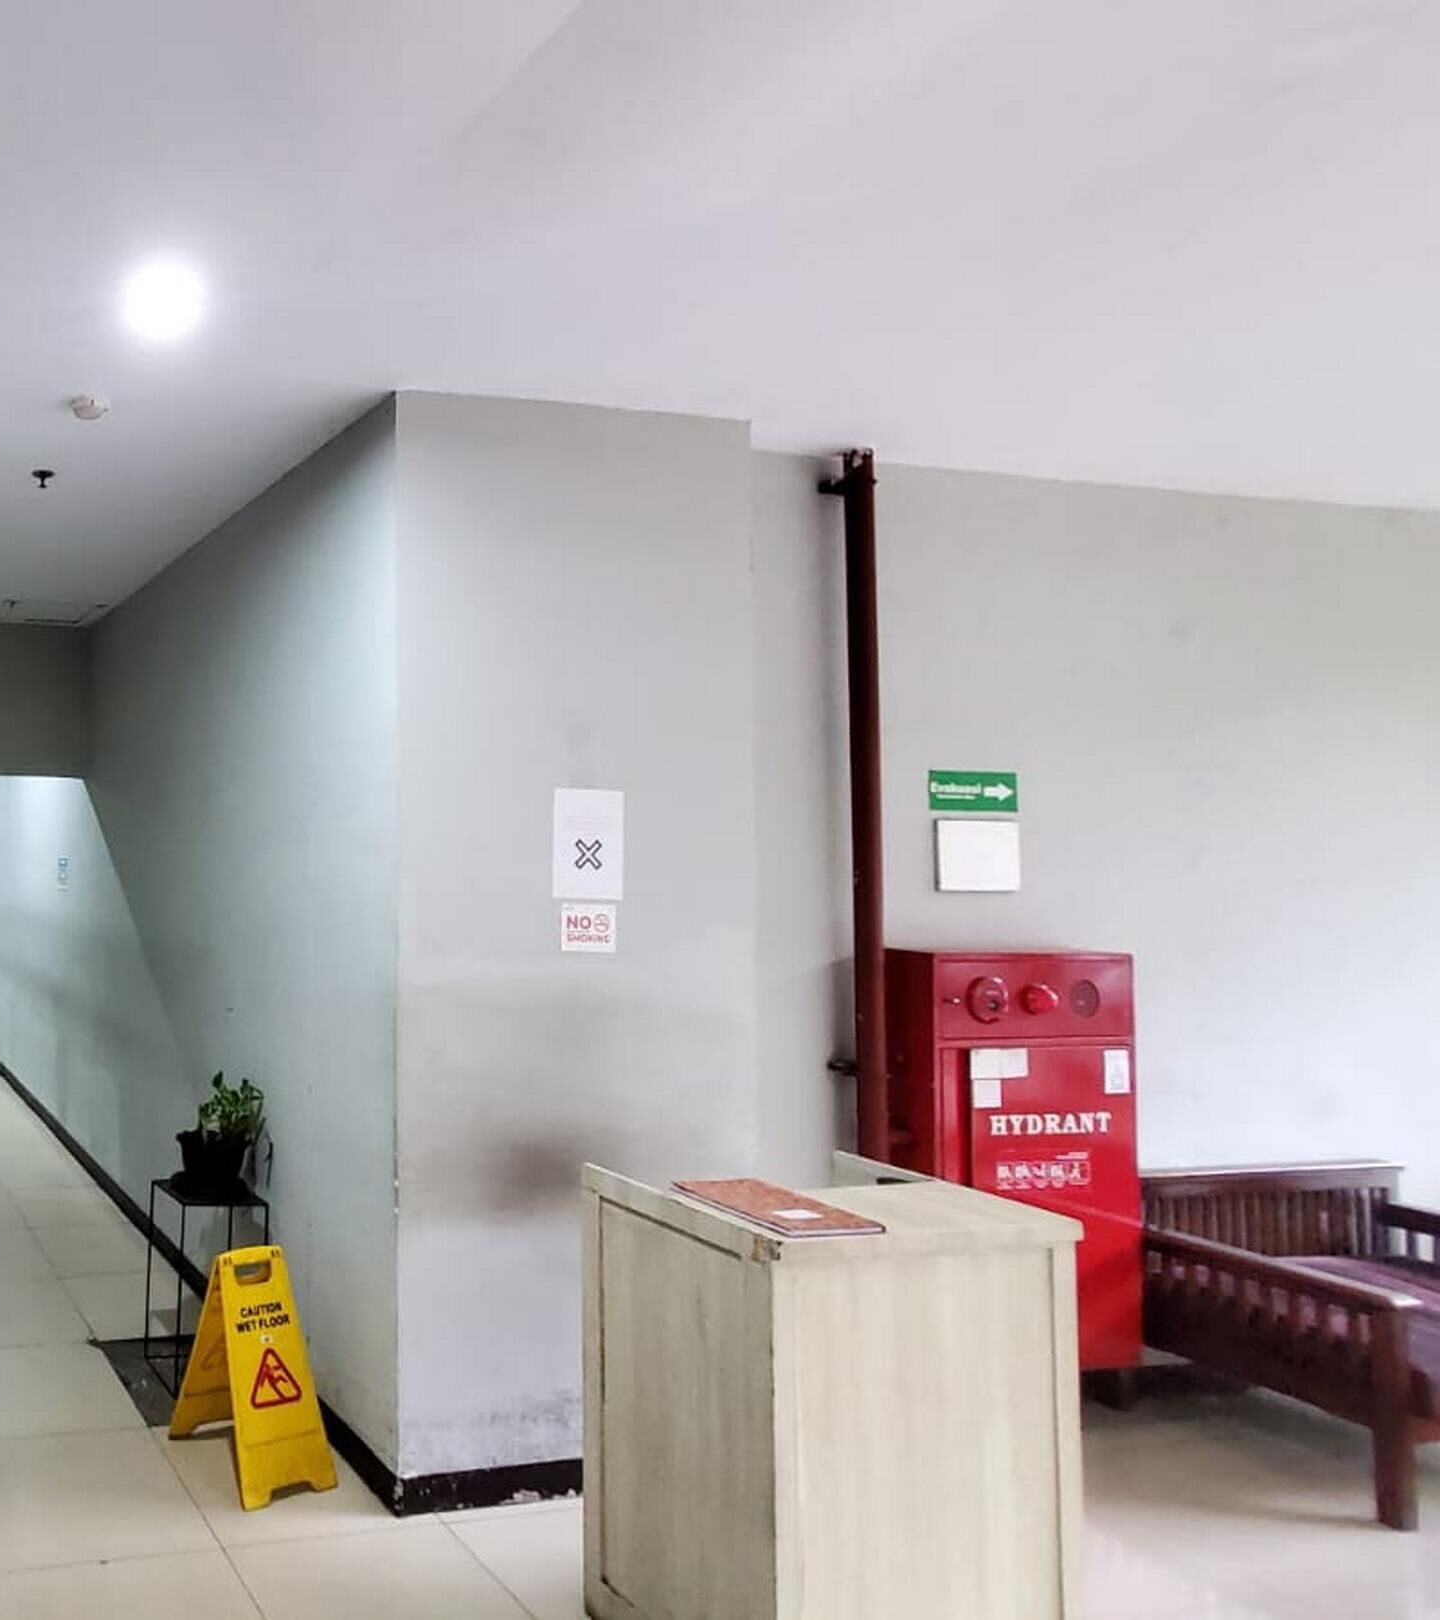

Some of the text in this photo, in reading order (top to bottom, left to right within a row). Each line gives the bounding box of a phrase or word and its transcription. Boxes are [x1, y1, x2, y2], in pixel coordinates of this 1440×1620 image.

[566, 915, 592, 930] NO
[567, 933, 611, 944] SMOKING
[989, 1111, 1112, 1136] HYDRANT
[240, 1302, 283, 1318] CAUTION
[236, 1313, 291, 1333] WET FLOOR
